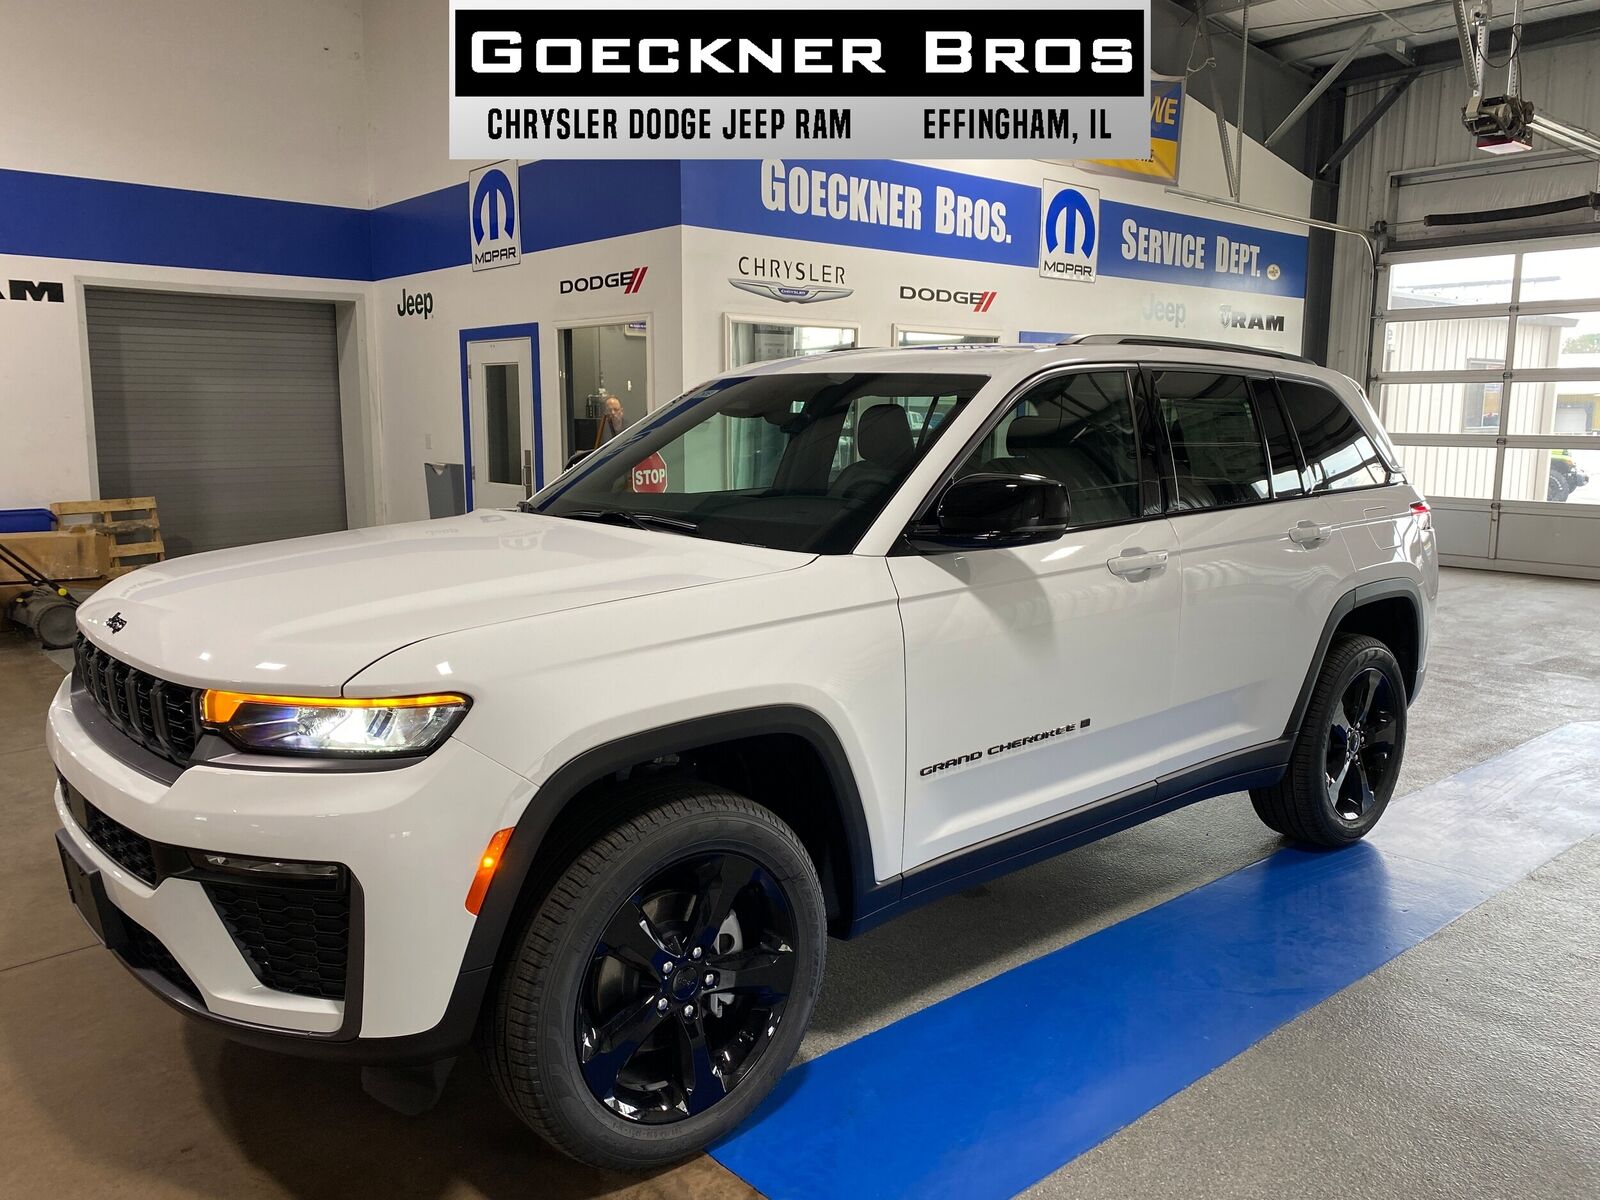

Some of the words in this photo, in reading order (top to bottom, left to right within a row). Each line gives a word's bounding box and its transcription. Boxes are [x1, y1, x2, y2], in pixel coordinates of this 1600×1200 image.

[761, 159, 923, 231] GOECKNER
[935, 186, 1012, 244] BROS.
[474, 246, 517, 265] MOPAR
[1121, 218, 1206, 270] SERVICE
[1215, 235, 1261, 278] DEPT.
[738, 256, 846, 285] CHRYSLER
[1043, 260, 1092, 277] MOPAR
[0, 279, 65, 303] M
[560, 270, 633, 295] DODGE
[397, 288, 434, 320] Jeep
[900, 286, 984, 305] DODGE
[1142, 294, 1187, 328] Jeep
[1230, 311, 1285, 332] RAM
[635, 468, 666, 486] STOP
[919, 751, 983, 777] GRAND
[987, 723, 1077, 756] CHEROKEE
